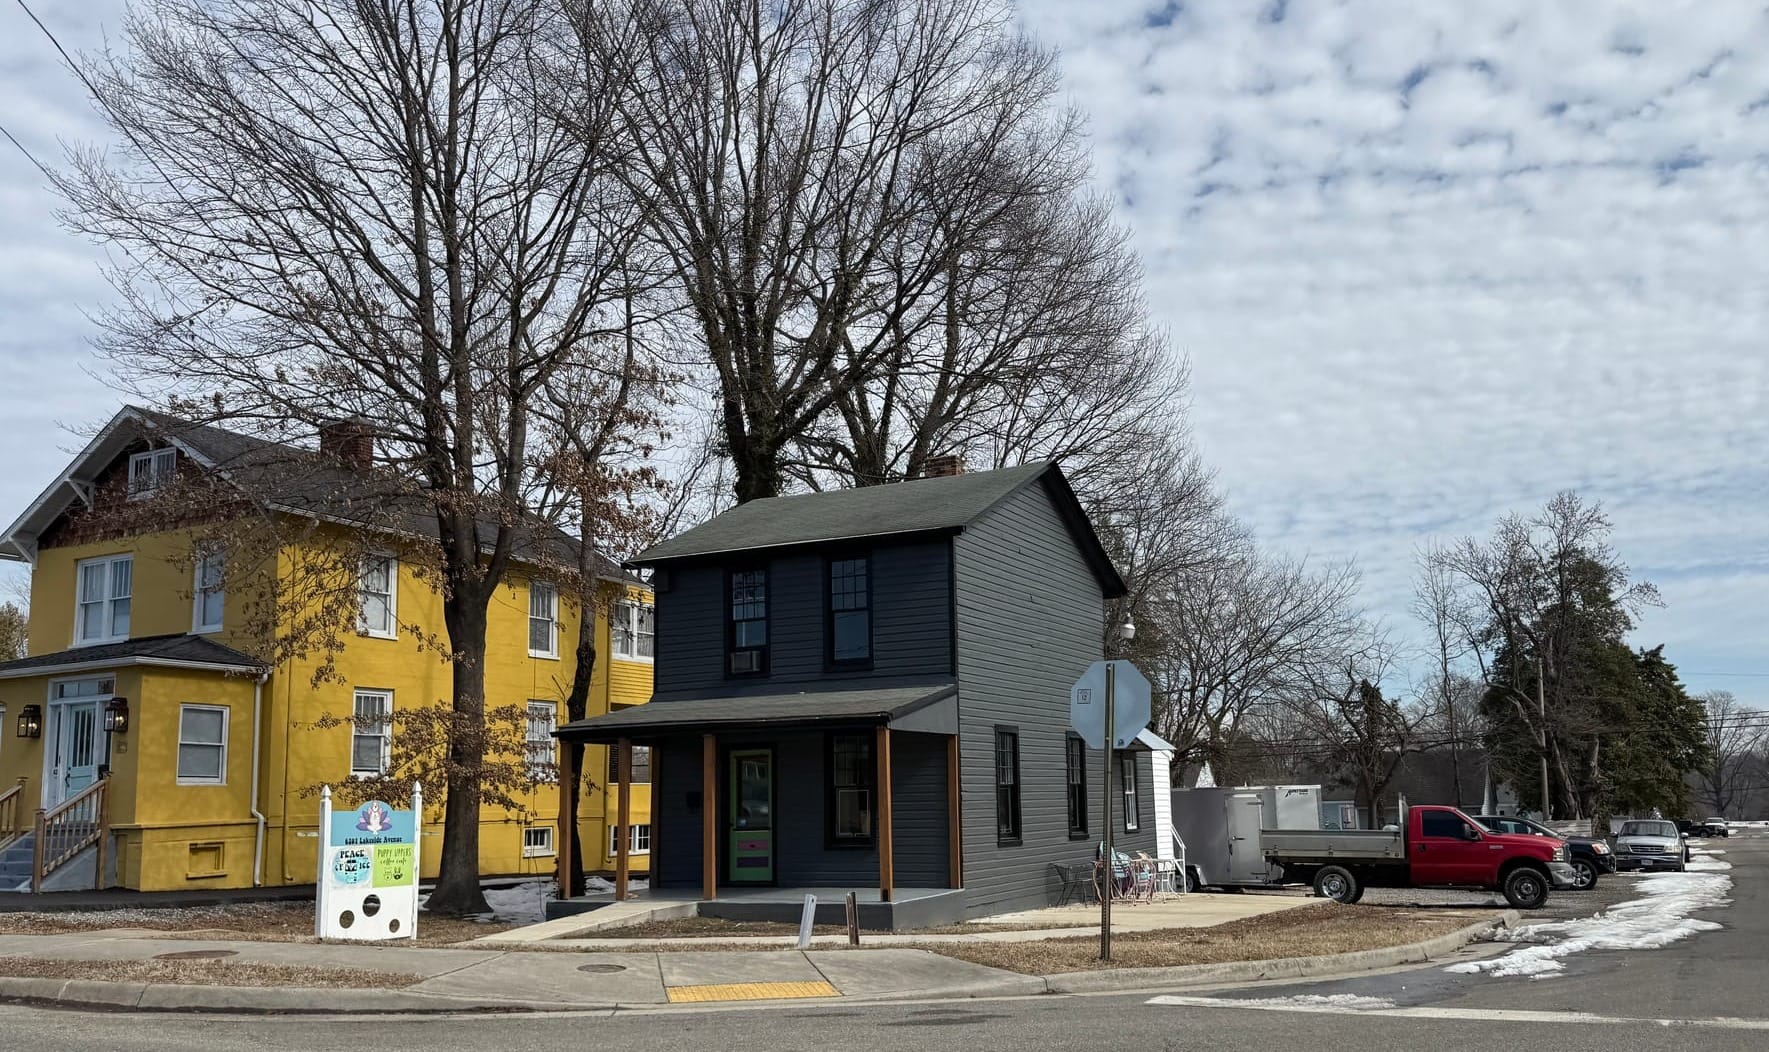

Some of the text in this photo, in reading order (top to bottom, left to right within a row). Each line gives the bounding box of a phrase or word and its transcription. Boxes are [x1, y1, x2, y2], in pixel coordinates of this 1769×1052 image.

[340, 849, 365, 859] PEACE
[377, 848, 412, 858] PUPPY UPPERS
